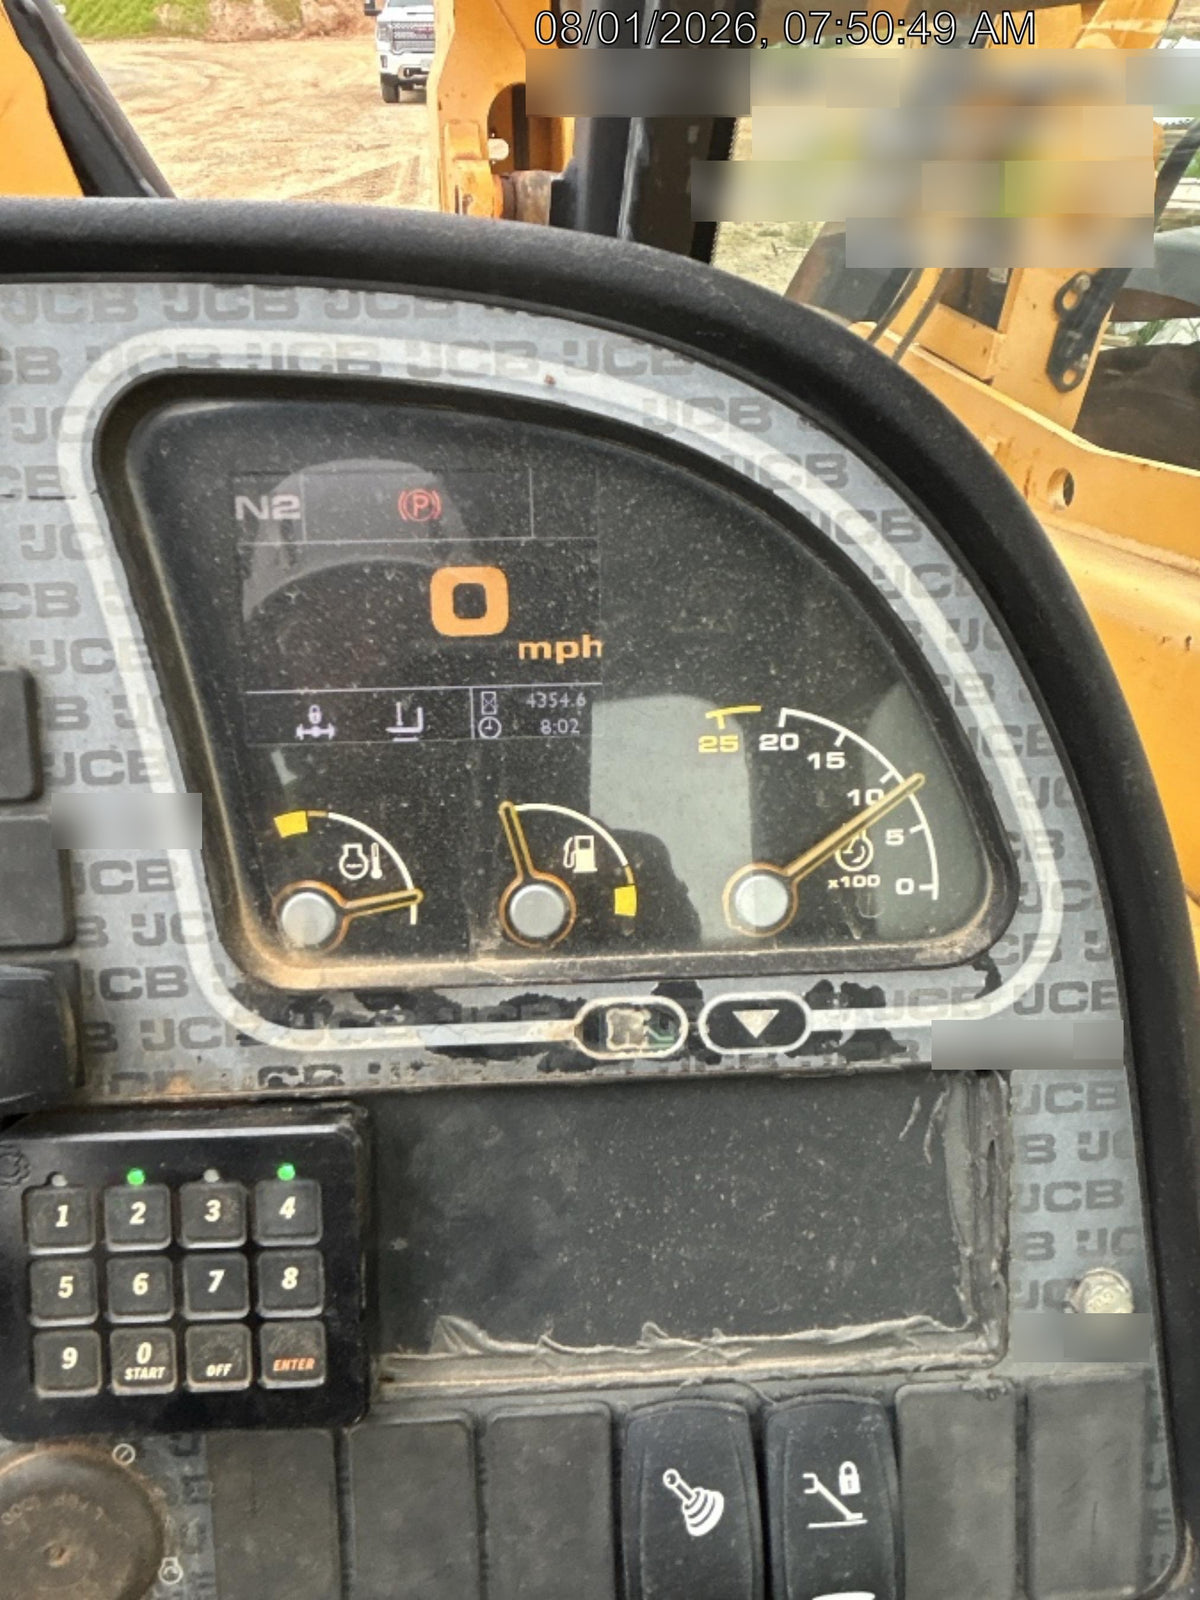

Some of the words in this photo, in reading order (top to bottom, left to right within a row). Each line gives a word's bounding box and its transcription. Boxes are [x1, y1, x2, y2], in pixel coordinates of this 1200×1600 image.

[163, 284, 300, 321] JCB
[403, 340, 541, 378] JCB
[642, 397, 773, 434] JCB
[235, 495, 301, 521] N2
[430, 565, 509, 637] 0
[518, 634, 604, 665] mph
[540, 717, 580, 735] 8:02
[698, 734, 739, 753] 25
[758, 733, 799, 751] 20
[806, 752, 846, 770] 15
[846, 788, 885, 807] 10
[885, 828, 905, 846] 5
[895, 878, 915, 895] 0
[55, 1205, 69, 1227] 1
[129, 1201, 147, 1225] 2
[204, 1199, 221, 1222] 3
[279, 1196, 296, 1219] 4
[58, 1276, 74, 1298] 5
[132, 1272, 149, 1295] 6
[208, 1269, 225, 1293] 7
[281, 1266, 299, 1290] 8
[61, 1347, 78, 1370] 9
[136, 1342, 152, 1364] 0
[124, 1366, 166, 1381] START
[205, 1363, 232, 1377] OFF
[272, 1357, 316, 1372] ENTER
